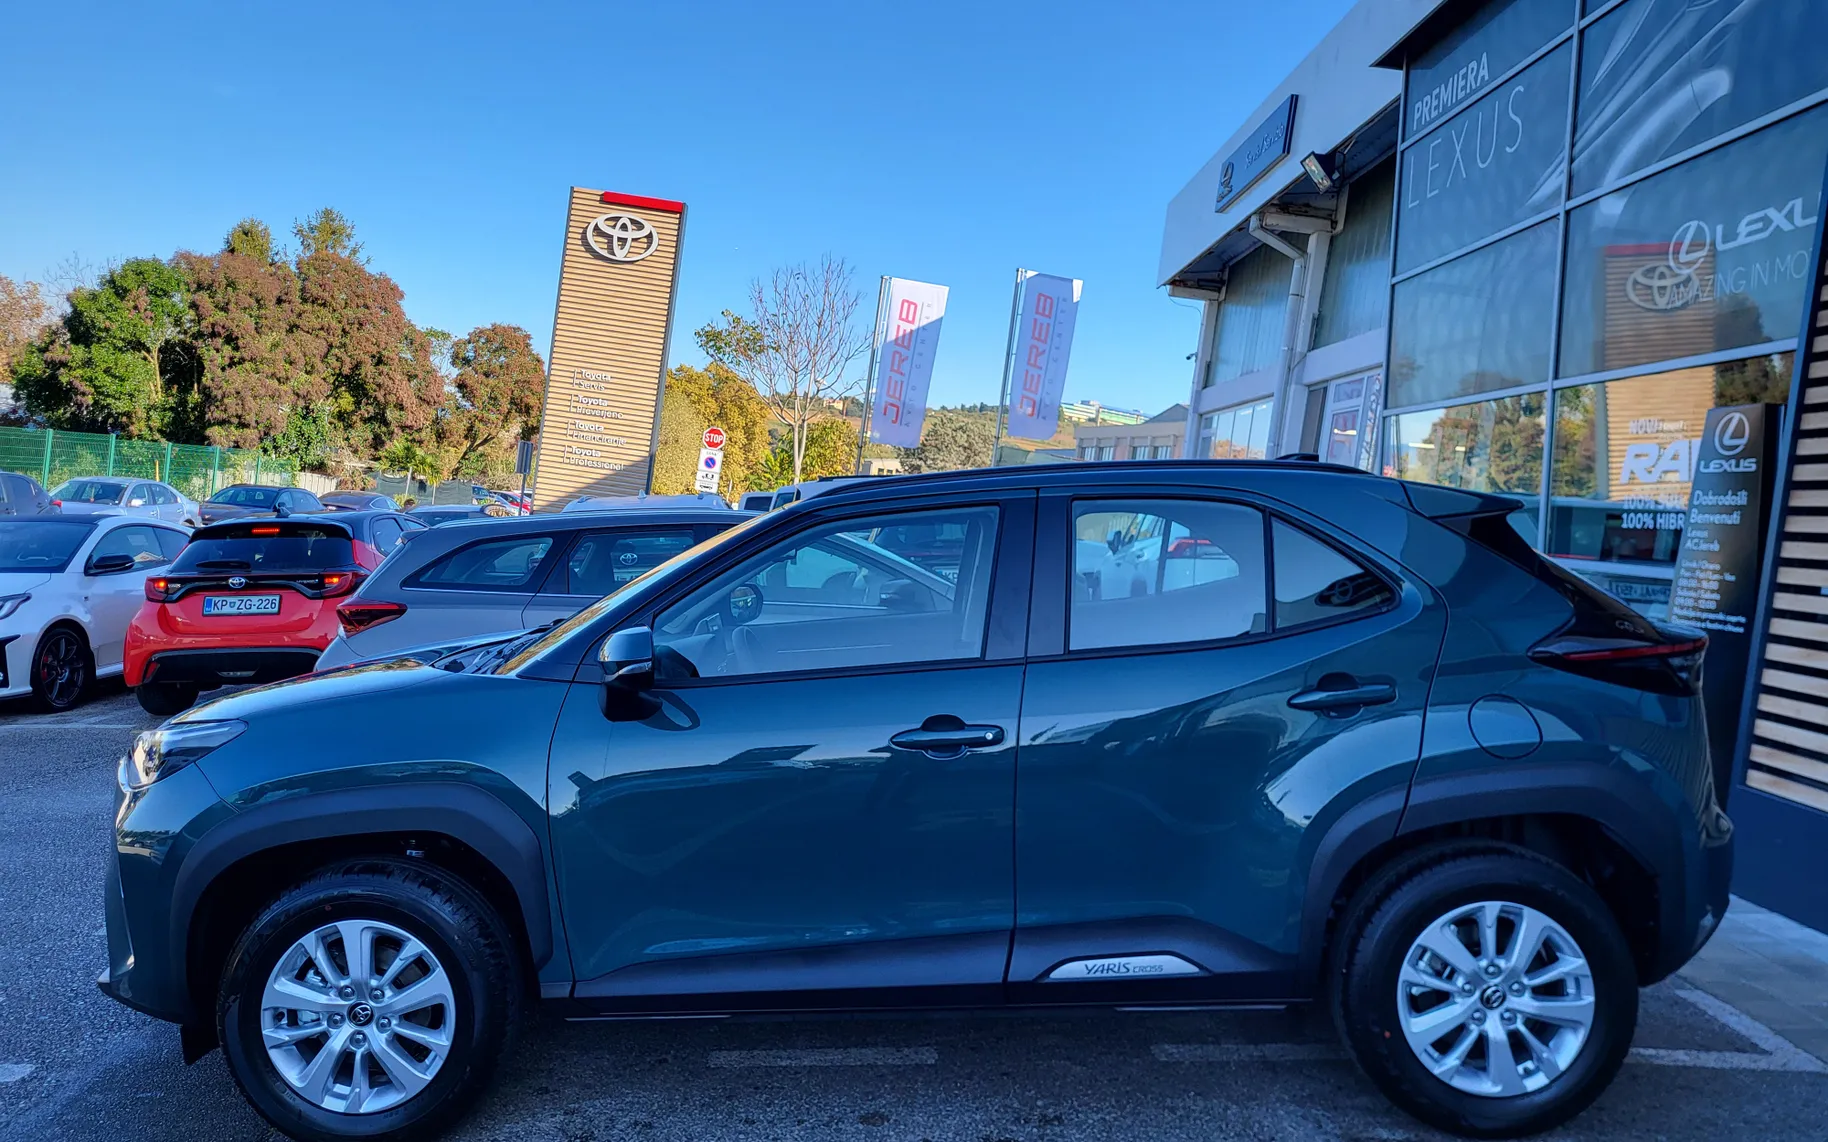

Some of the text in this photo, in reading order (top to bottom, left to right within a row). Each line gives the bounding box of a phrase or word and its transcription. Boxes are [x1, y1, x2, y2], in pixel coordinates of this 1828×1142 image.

[1413, 52, 1489, 131] PREMIERA
[1408, 85, 1524, 208] LEXUS
[1668, 266, 1747, 309] AMAZING
[1750, 261, 1770, 291] IN
[883, 298, 918, 425] JEREB
[1020, 292, 1054, 417] JEREB
[580, 369, 611, 382] Toyota
[578, 380, 605, 391] Servis
[577, 394, 608, 407] Toyota
[574, 420, 604, 432] Toyota
[572, 430, 627, 446] Financiranje
[705, 433, 724, 444] STOP
[571, 445, 601, 457] Toyota
[569, 456, 624, 471] Professional
[1699, 458, 1757, 473] LEXUS
[1693, 489, 1748, 506] Dobrodošli
[1621, 512, 1654, 529] 100%
[1690, 508, 1741, 525] Benvenuti
[213, 598, 277, 611] KP ZG-226
[1084, 961, 1164, 975] YARIS CROSS
